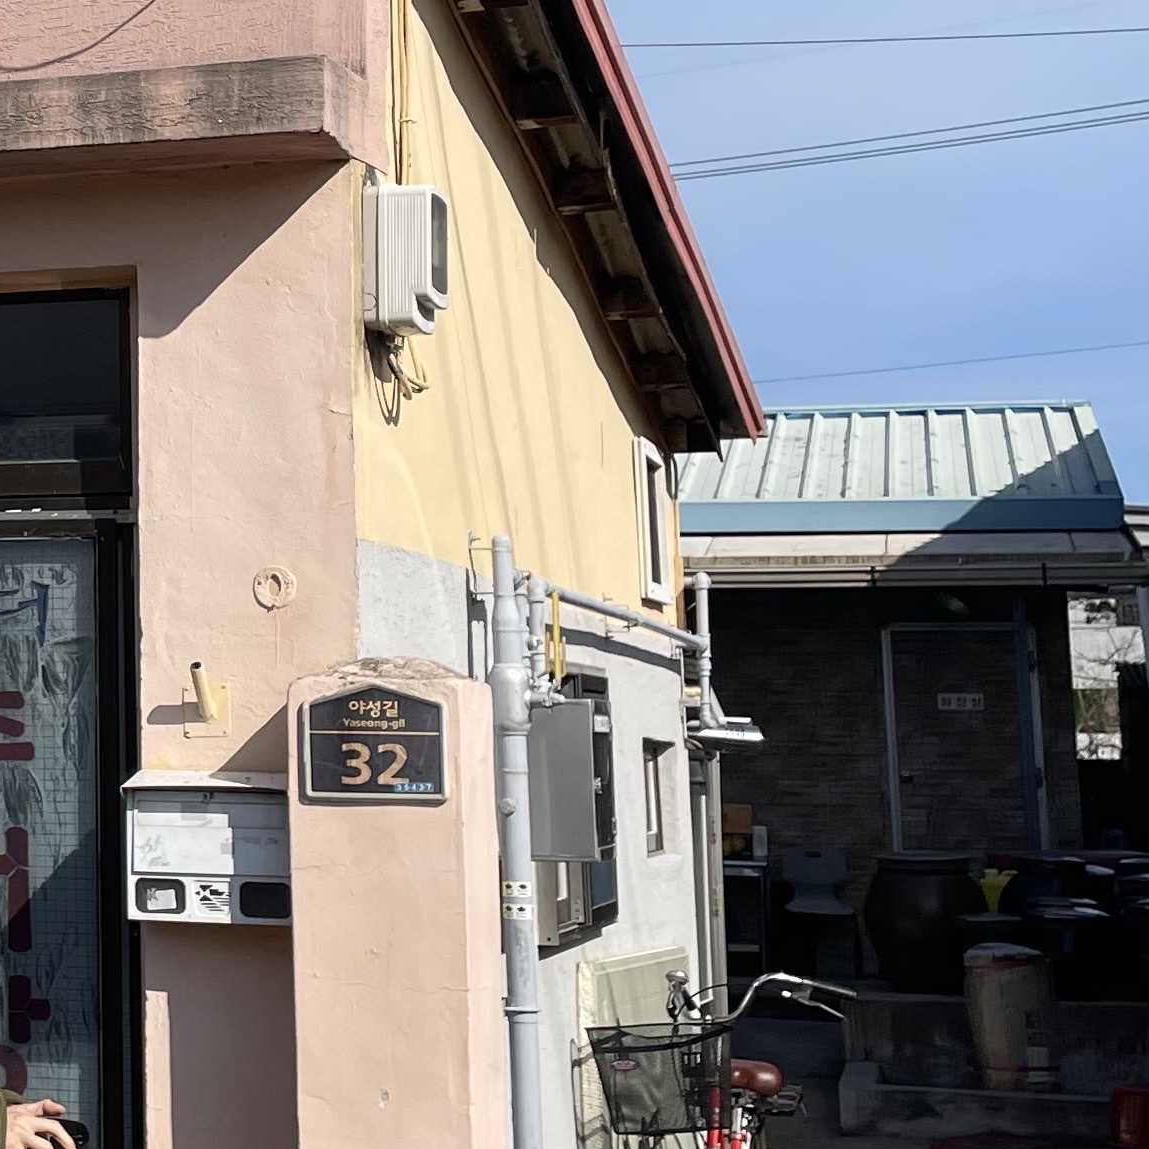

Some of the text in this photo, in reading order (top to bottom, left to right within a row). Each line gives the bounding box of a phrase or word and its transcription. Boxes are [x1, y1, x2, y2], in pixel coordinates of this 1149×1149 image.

[348, 700, 399, 718] 야성길
[342, 718, 406, 730] Yaseong-gil
[341, 742, 410, 786] 32
